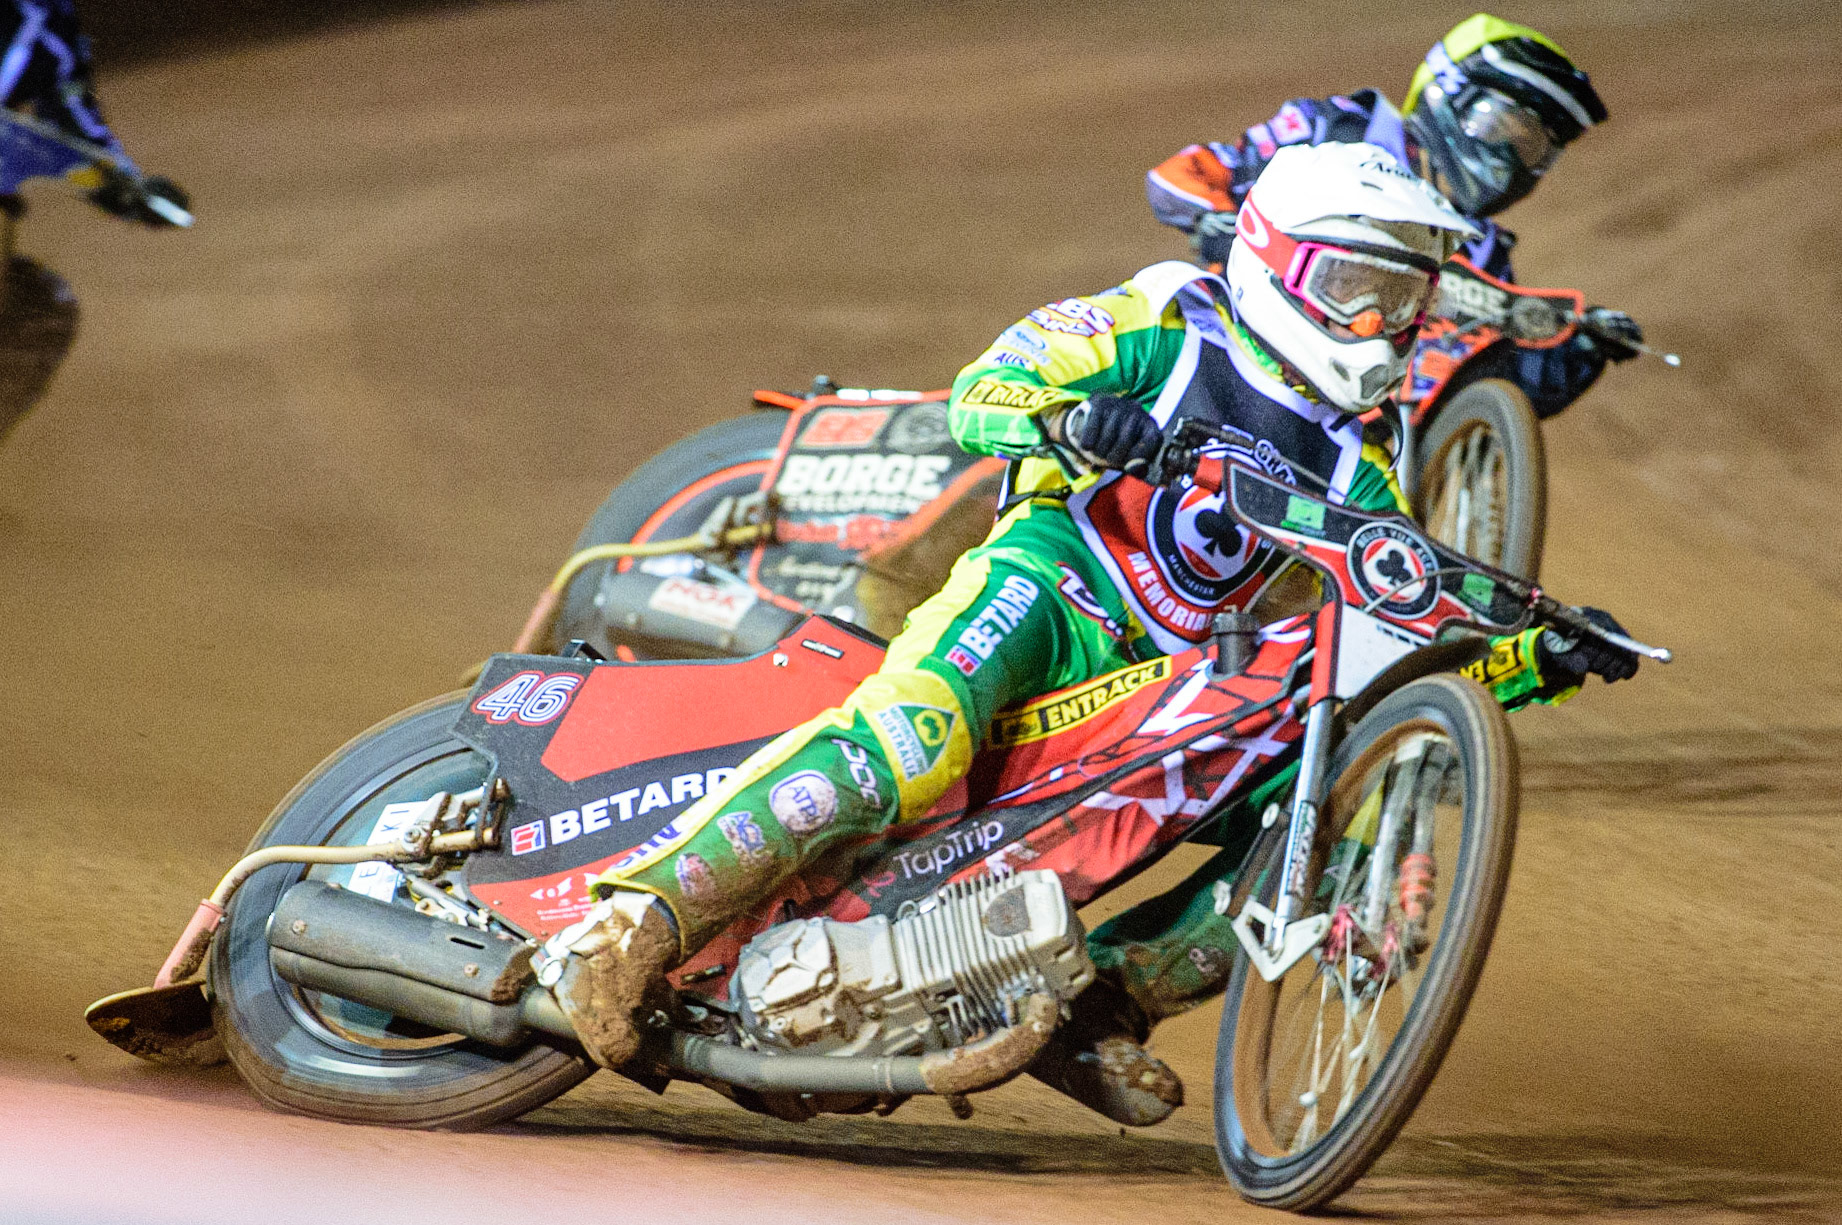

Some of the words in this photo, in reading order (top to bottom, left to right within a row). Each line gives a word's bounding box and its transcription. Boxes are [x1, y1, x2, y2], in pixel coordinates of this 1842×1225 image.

[777, 454, 951, 500] BORGE
[958, 575, 1040, 661] BETARD
[471, 670, 584, 727] 46
[1047, 664, 1157, 729] ENTRACK
[550, 767, 738, 846] BETARD
[893, 821, 1005, 879] TapTrip
